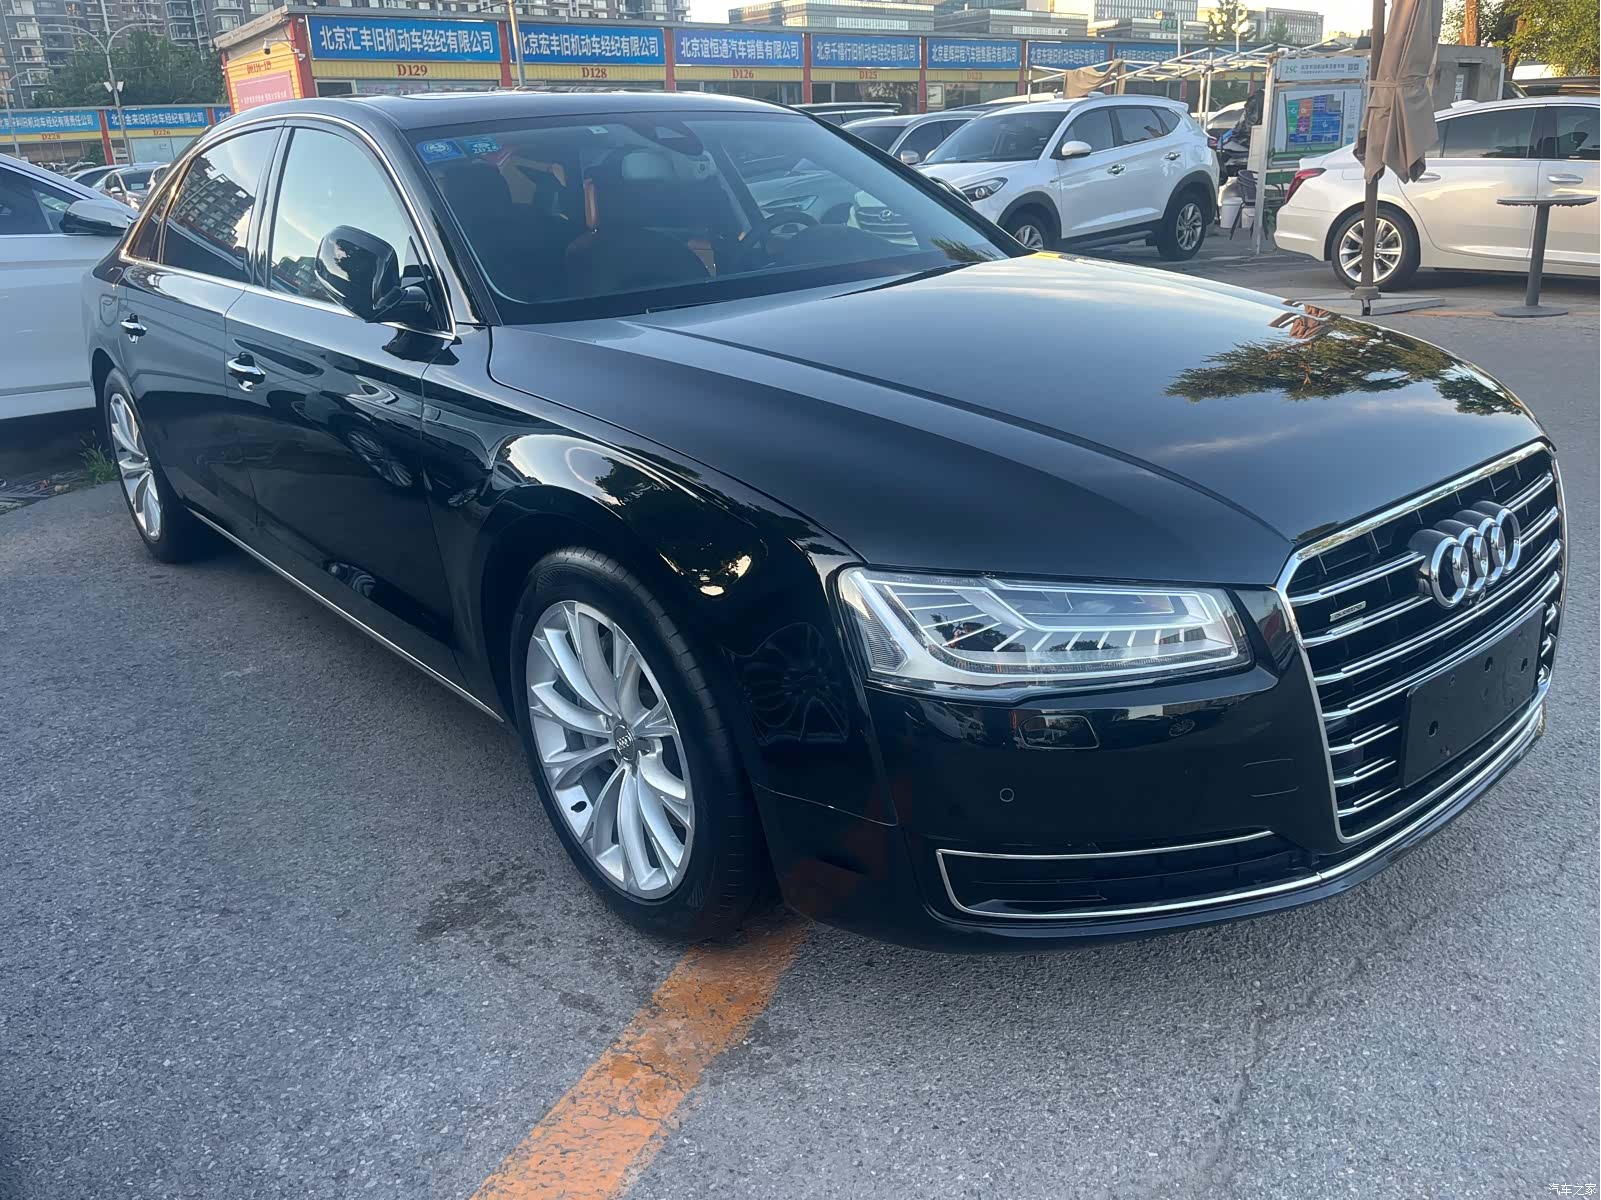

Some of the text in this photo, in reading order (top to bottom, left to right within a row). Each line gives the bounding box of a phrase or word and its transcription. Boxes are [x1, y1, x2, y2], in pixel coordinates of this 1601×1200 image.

[319, 25, 494, 54] 北京汇丰旧机动车经纪有限公司
[519, 32, 659, 57] 北京宏丰旧机动车经纪有限公司
[680, 37, 799, 60] 北京谊恒通汽车销售有限公司
[397, 64, 428, 77] D129
[582, 67, 607, 79] D128
[732, 69, 754, 79] D126
[859, 70, 878, 80] D125
